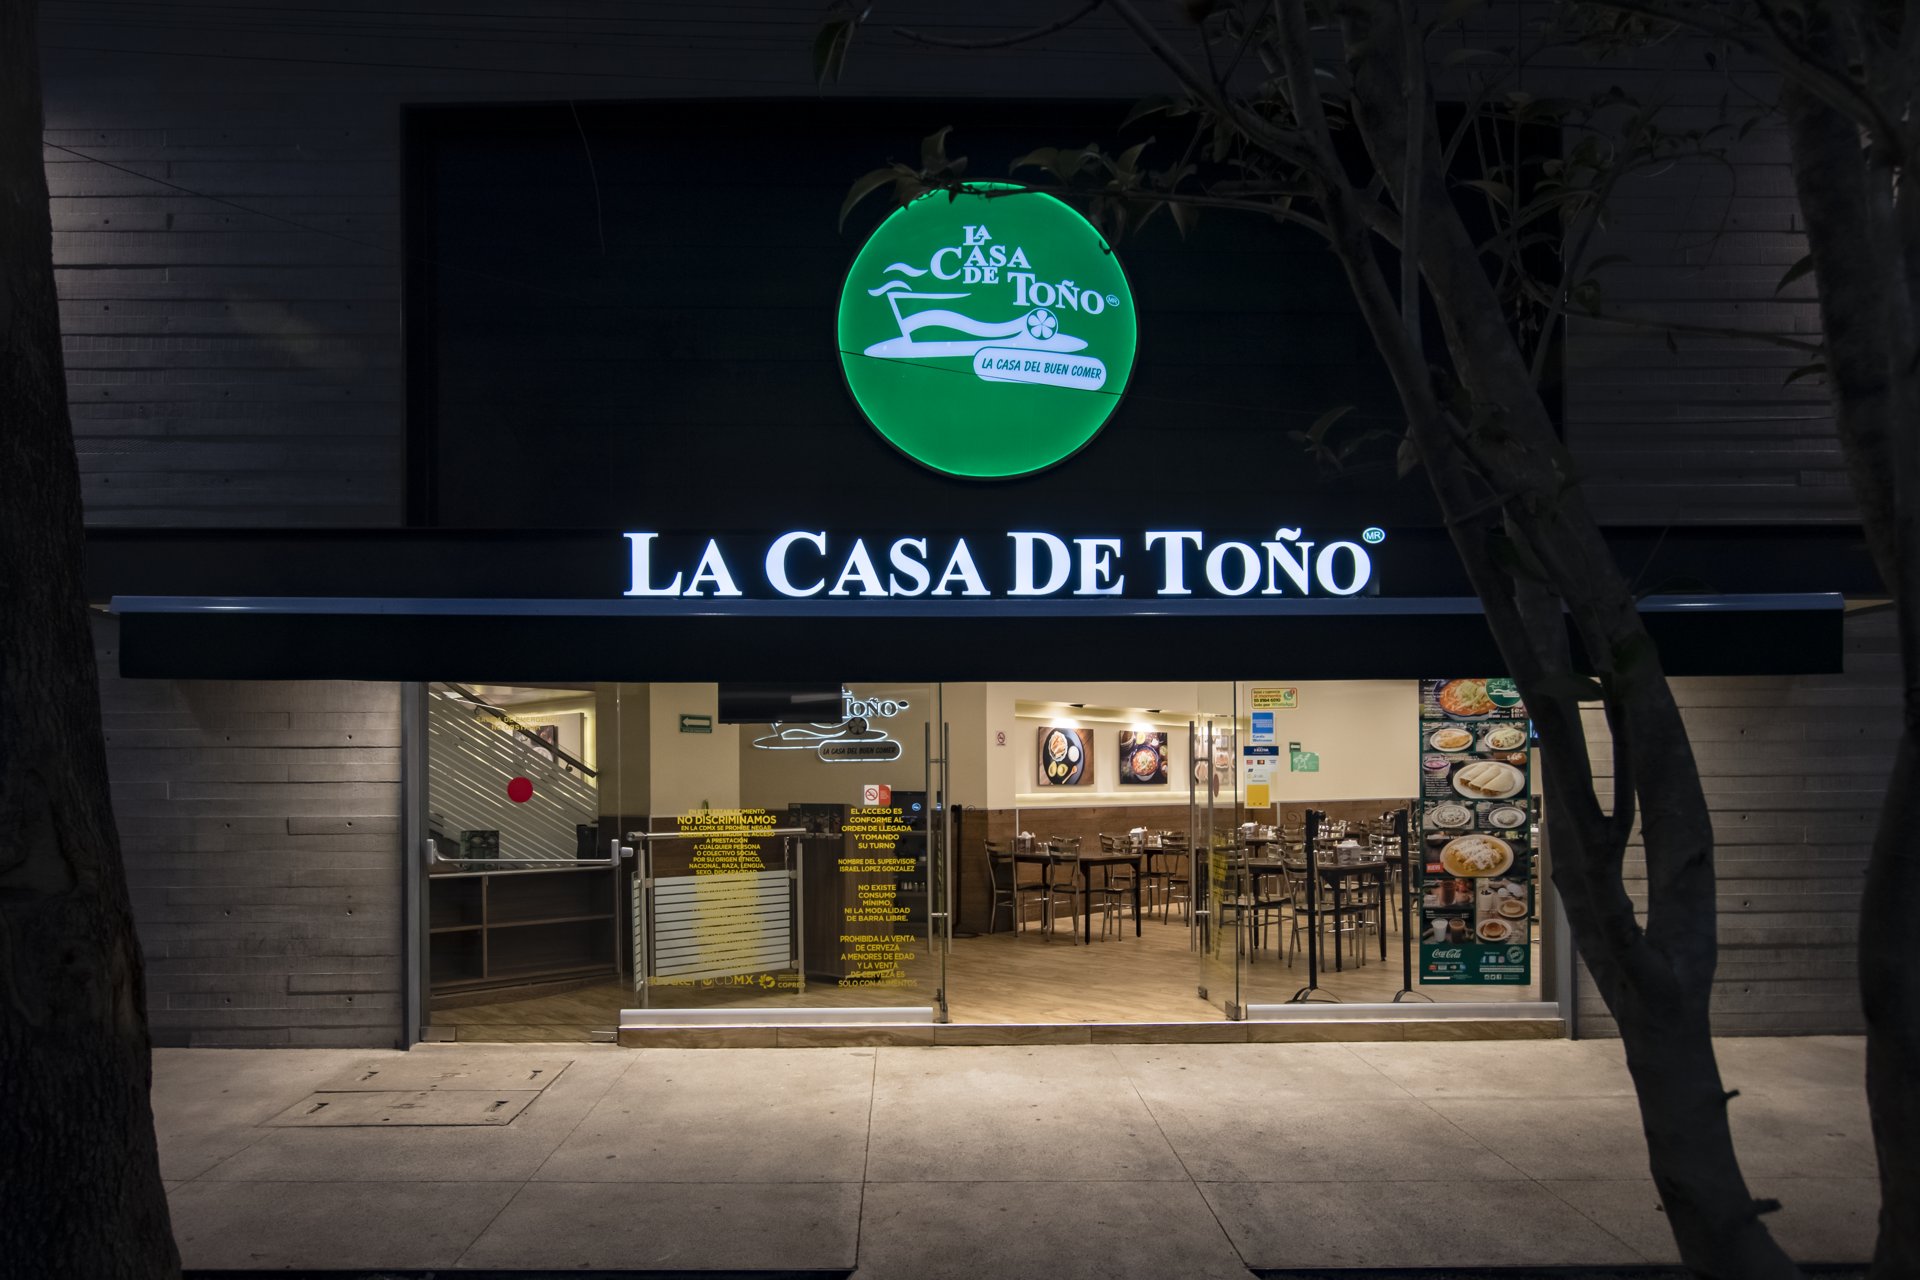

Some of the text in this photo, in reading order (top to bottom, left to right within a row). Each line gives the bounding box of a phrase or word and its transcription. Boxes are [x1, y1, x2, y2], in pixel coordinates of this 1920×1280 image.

[962, 224, 992, 246] LA
[930, 245, 1032, 280] CASA
[962, 266, 999, 284] DE
[1007, 272, 1105, 315] TOÑO
[981, 357, 1102, 380] LA CASA DEL BUEN COMER
[623, 531, 743, 597] LA
[764, 530, 991, 599] CASA
[1006, 531, 1125, 598] DE
[1145, 526, 1372, 598] TOÑO
[677, 816, 777, 824] NO DISCRIMINAMOS
[714, 975, 754, 985] CDMX
